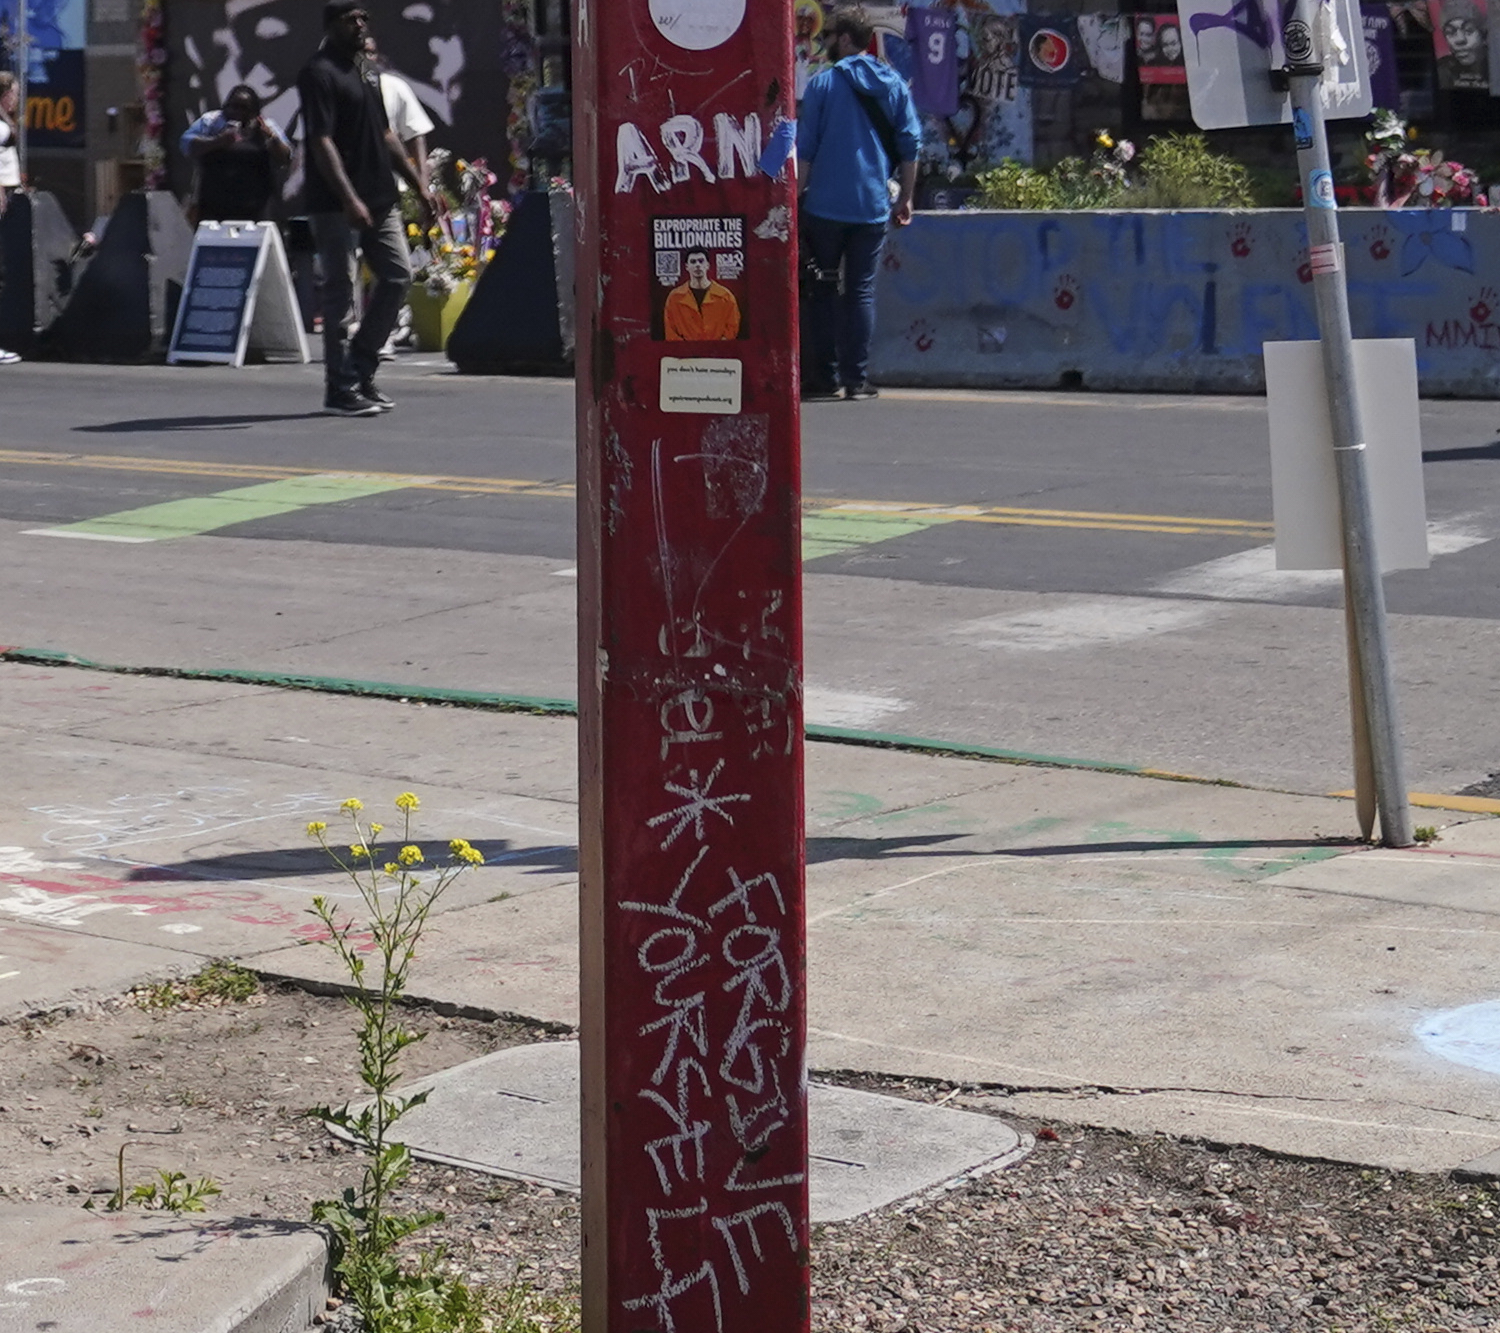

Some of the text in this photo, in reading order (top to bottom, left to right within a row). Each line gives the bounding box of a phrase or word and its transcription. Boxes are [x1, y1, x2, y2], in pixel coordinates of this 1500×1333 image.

[927, 31, 945, 65] 9
[653, 218, 743, 233] EXPROPRIATE THE
[653, 231, 743, 249] BILLIONAIRES
